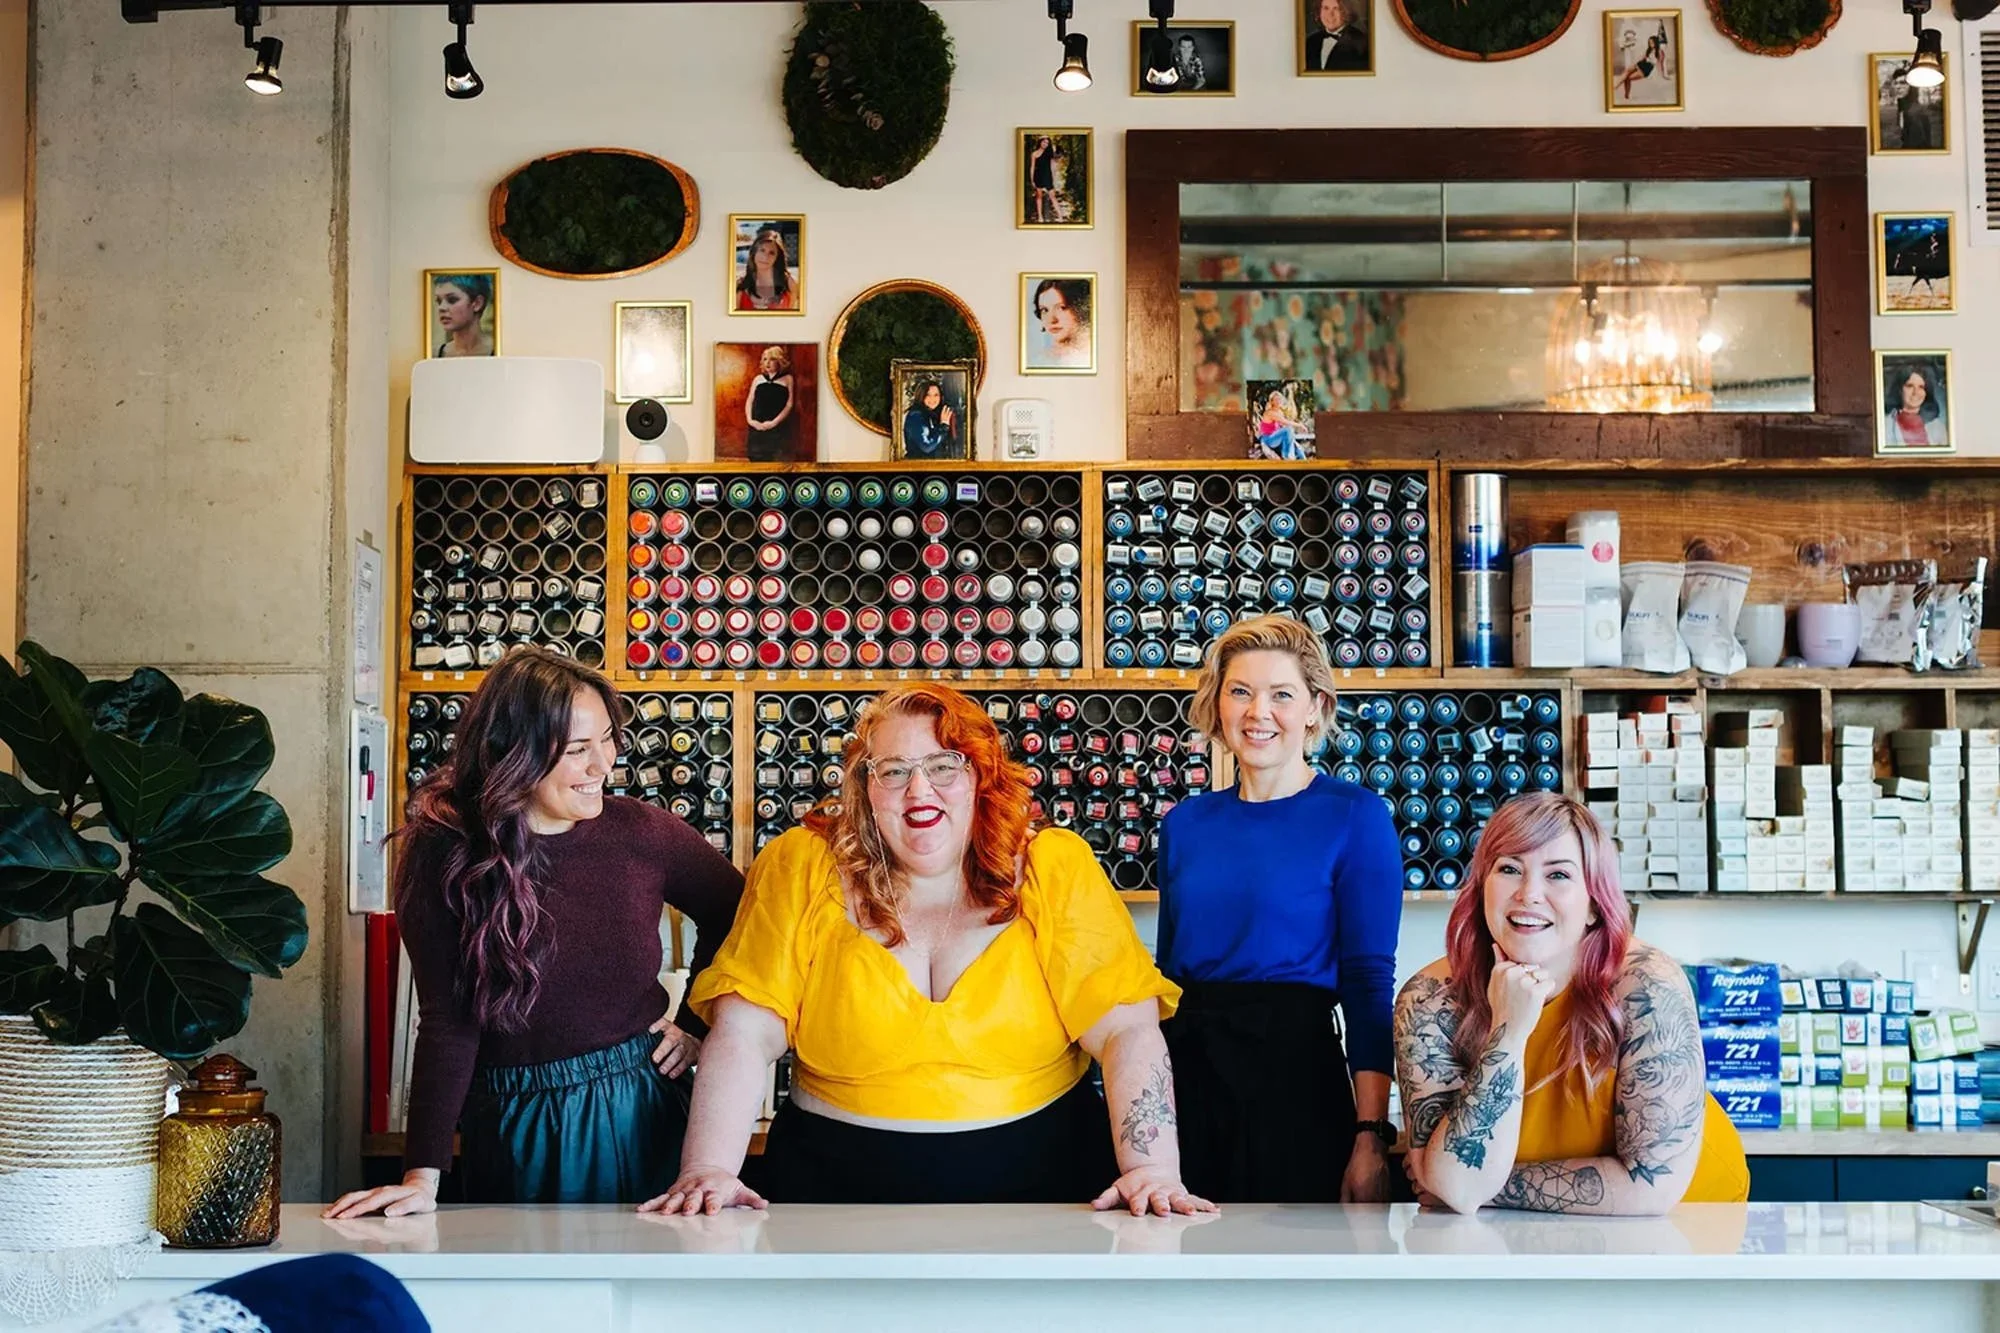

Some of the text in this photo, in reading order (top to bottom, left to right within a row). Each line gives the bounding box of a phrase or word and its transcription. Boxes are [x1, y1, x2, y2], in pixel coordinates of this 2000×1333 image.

[1712, 974, 1766, 989] Reynolds
[1724, 989, 1760, 1006] 721
[1724, 1043, 1761, 1059] 721
[1726, 1096, 1762, 1112] 721
